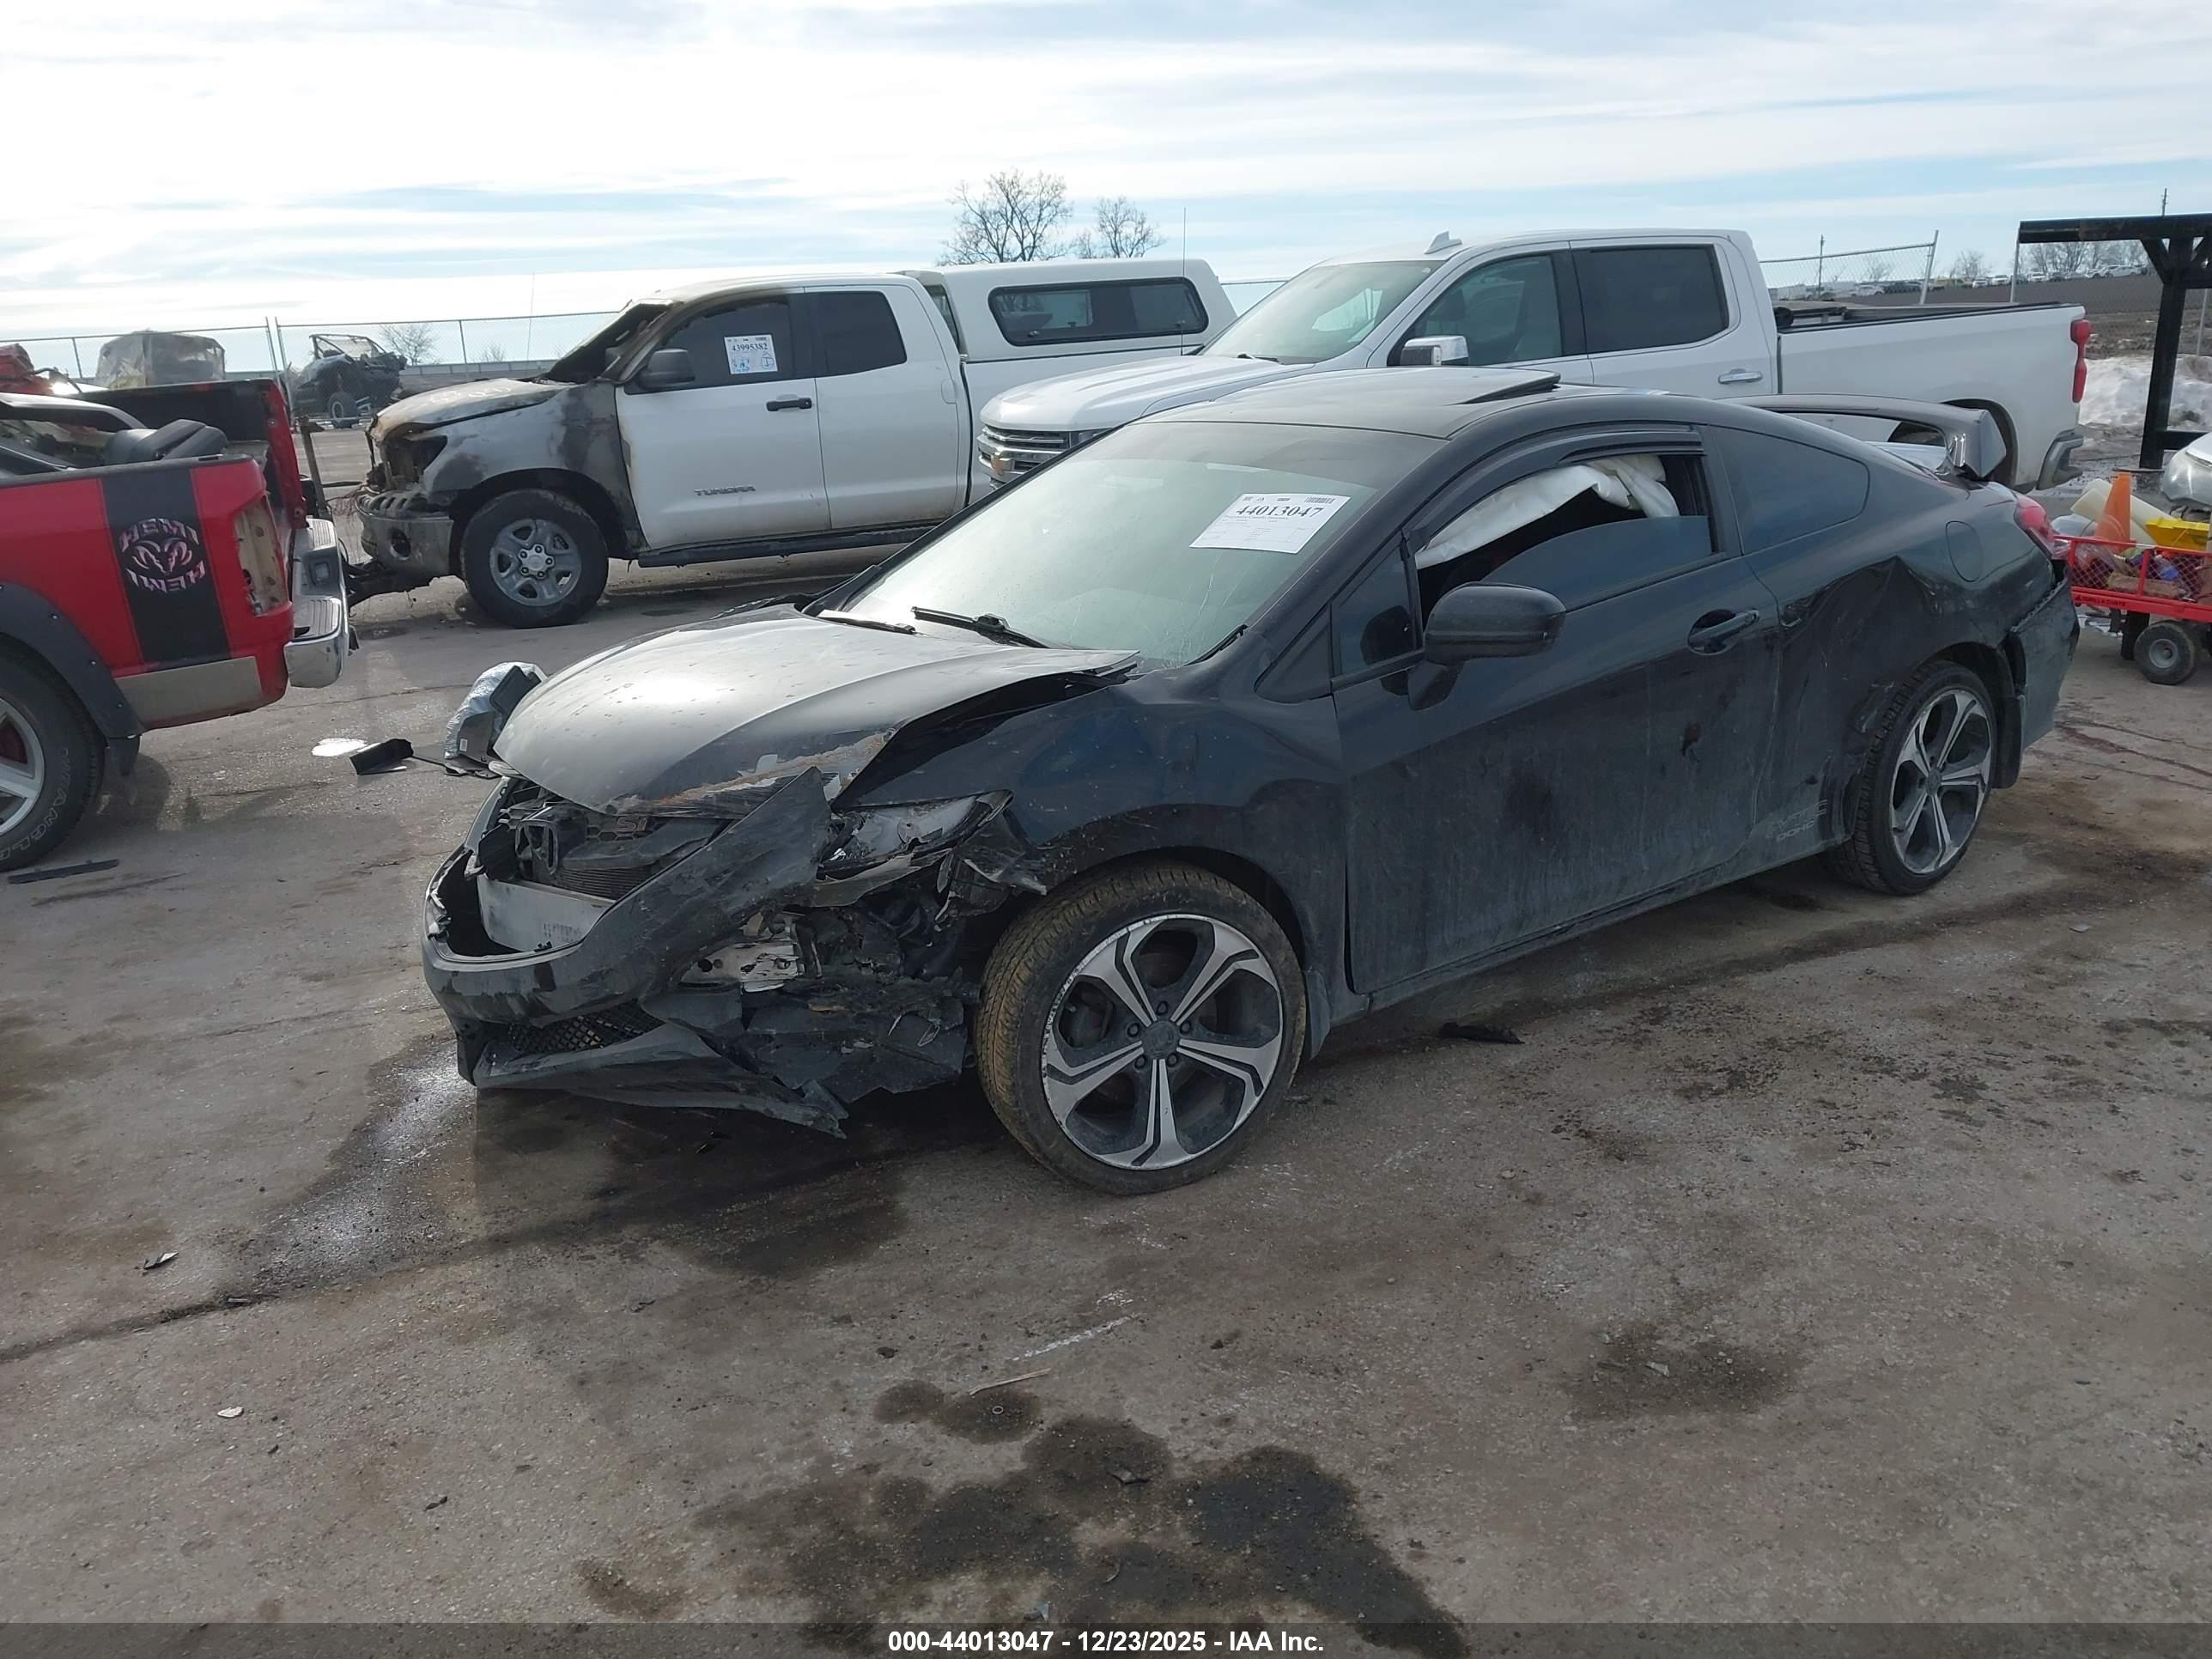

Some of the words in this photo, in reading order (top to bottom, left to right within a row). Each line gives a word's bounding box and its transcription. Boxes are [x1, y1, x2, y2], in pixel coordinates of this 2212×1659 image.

[731, 343, 769, 351] 43995382
[1237, 504, 1323, 518] 44013047
[118, 518, 199, 553] HEMI
